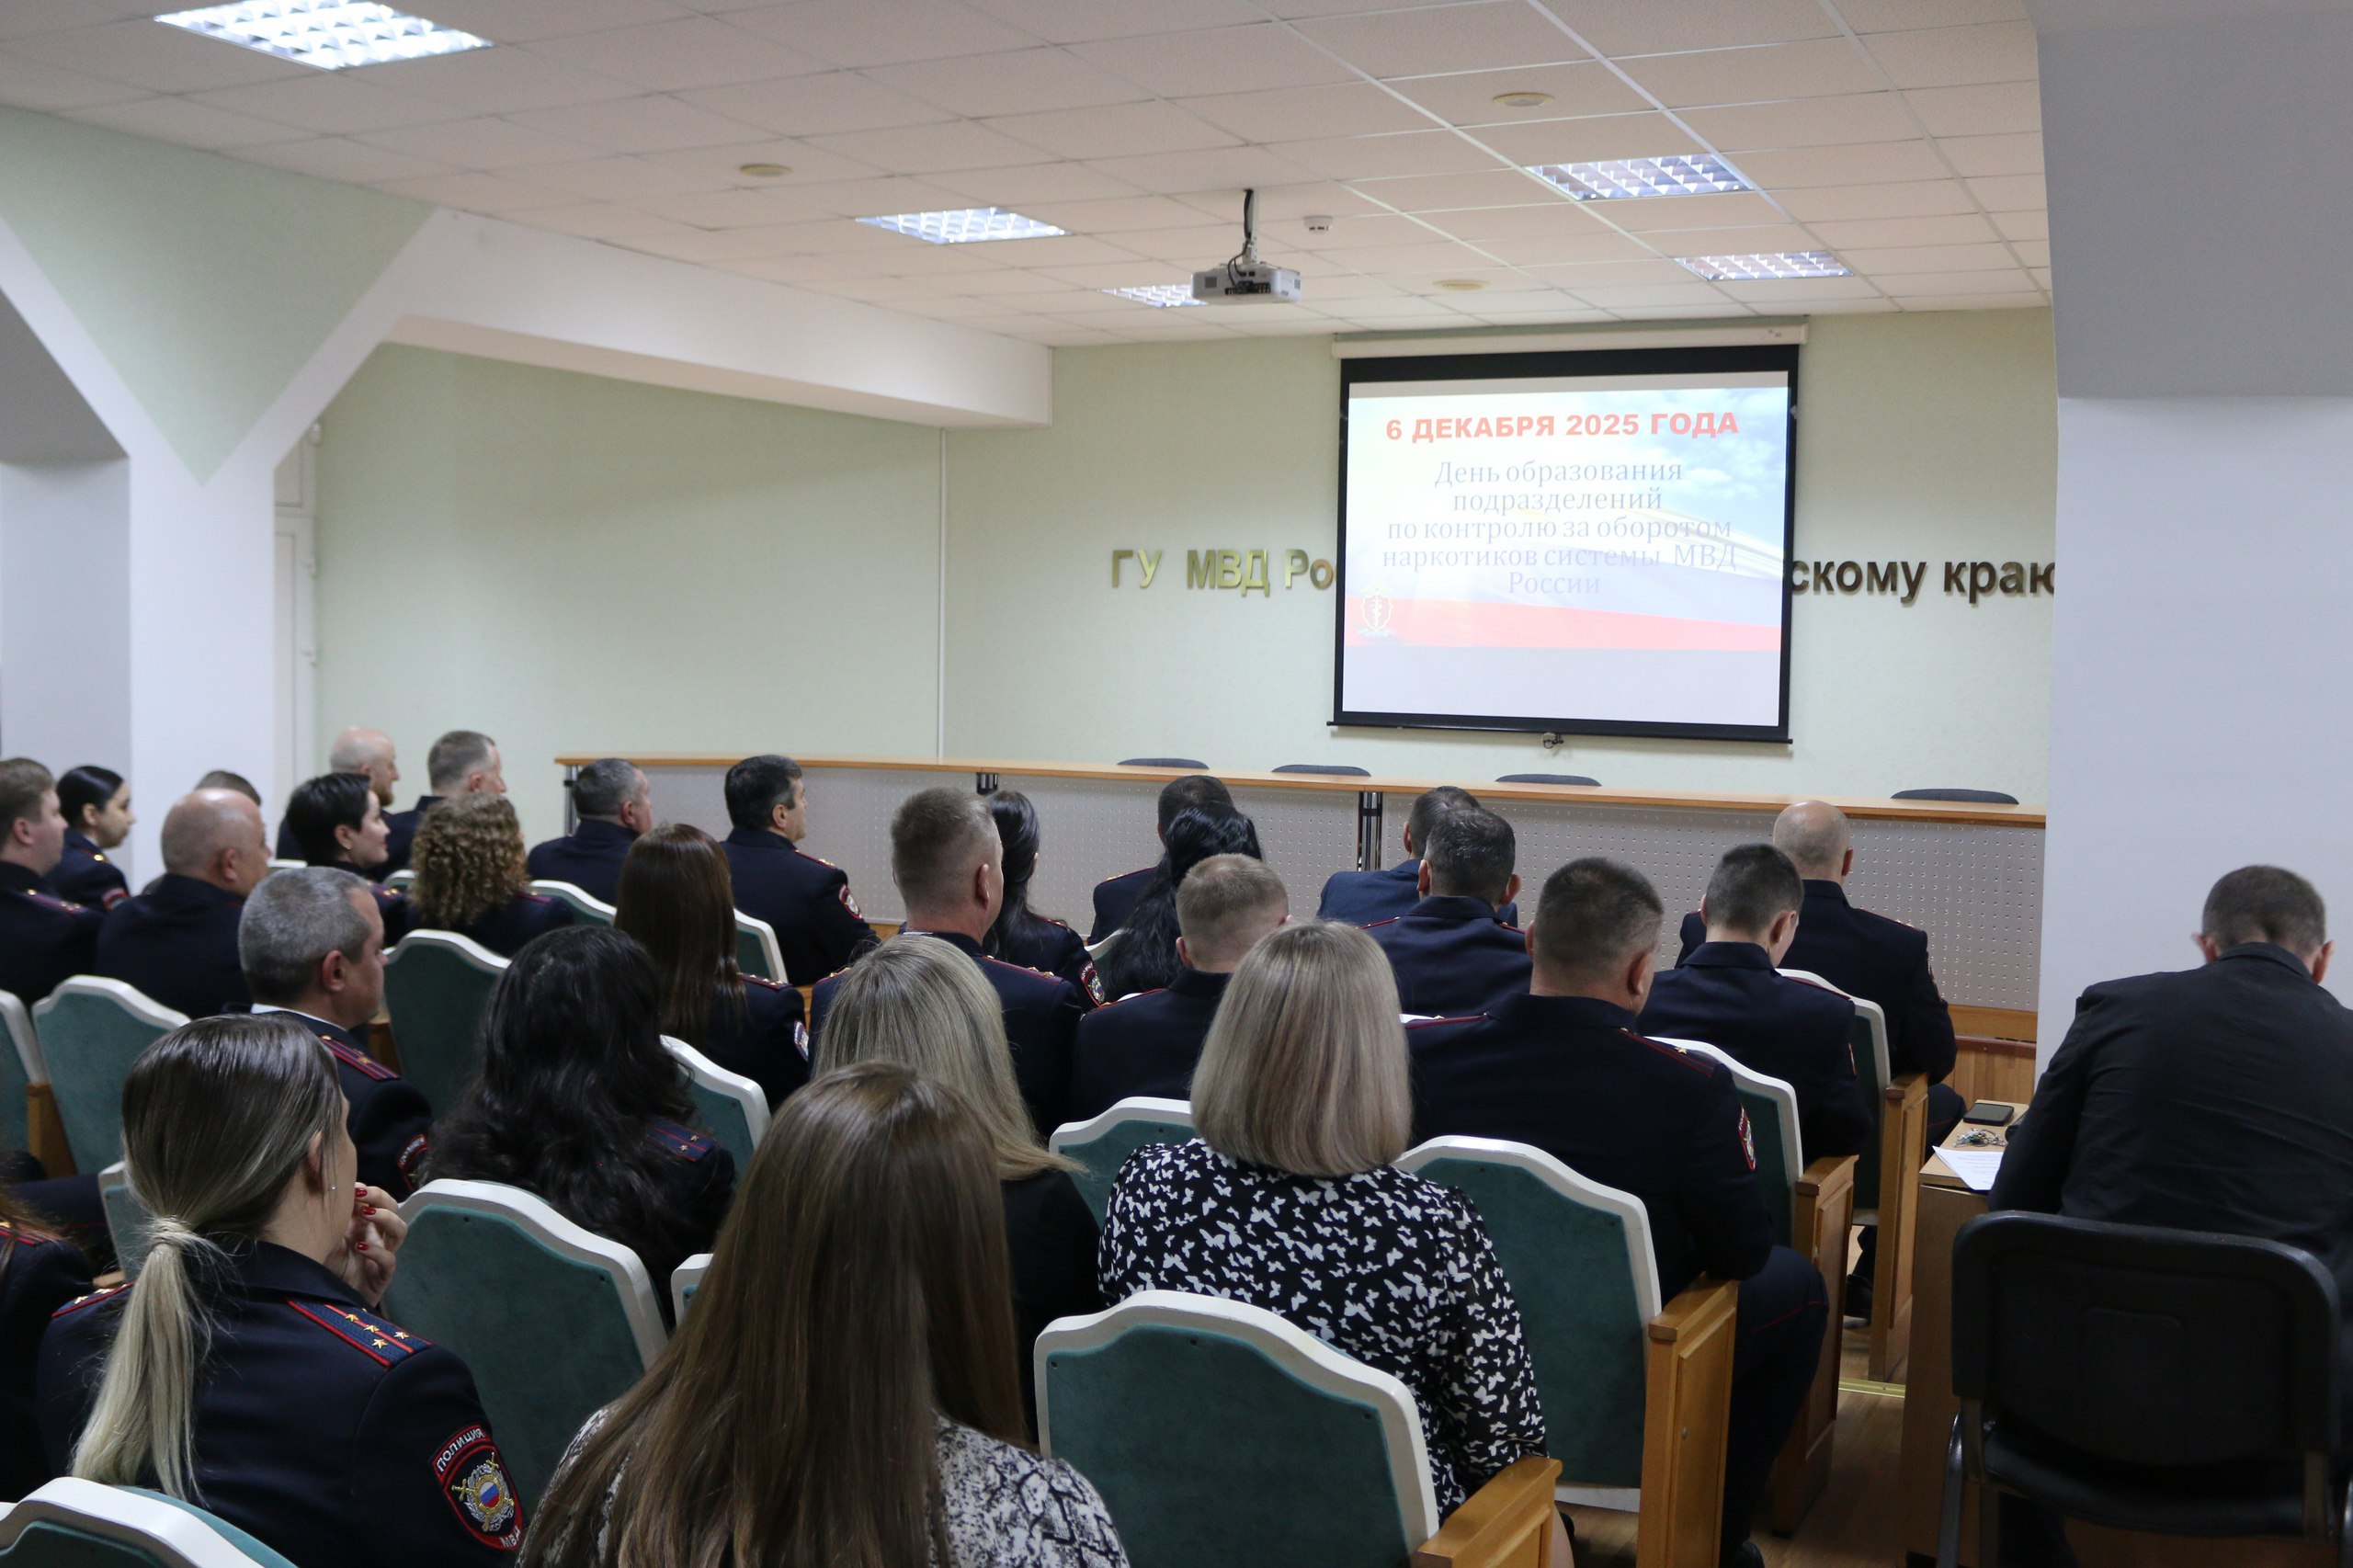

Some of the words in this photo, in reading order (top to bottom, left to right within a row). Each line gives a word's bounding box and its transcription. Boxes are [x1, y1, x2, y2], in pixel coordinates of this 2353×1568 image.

[1386, 419, 1403, 440] 6
[1412, 415, 1555, 443] ДЕКАБРЯ
[1566, 414, 1640, 436] 2025
[1651, 412, 1740, 438] ГОДА
[1435, 461, 1500, 488] День
[1506, 459, 1683, 487] образования
[1453, 486, 1663, 515] подразделений
[1388, 522, 1417, 540] по
[1424, 521, 1557, 544] контролю
[1563, 520, 1590, 538] за
[1597, 517, 1733, 542] оборотом
[1382, 546, 1538, 571] наркотиков
[1544, 544, 1661, 566] системы
[1673, 543, 1736, 571] МВД
[1111, 550, 1162, 589] ГУ
[1187, 550, 1270, 597] МВД
[1284, 550, 1336, 590] Ро
[1790, 561, 1927, 604] скому
[1508, 572, 1601, 596] России
[436, 1427, 486, 1472] ПОЛИЦИЯ
